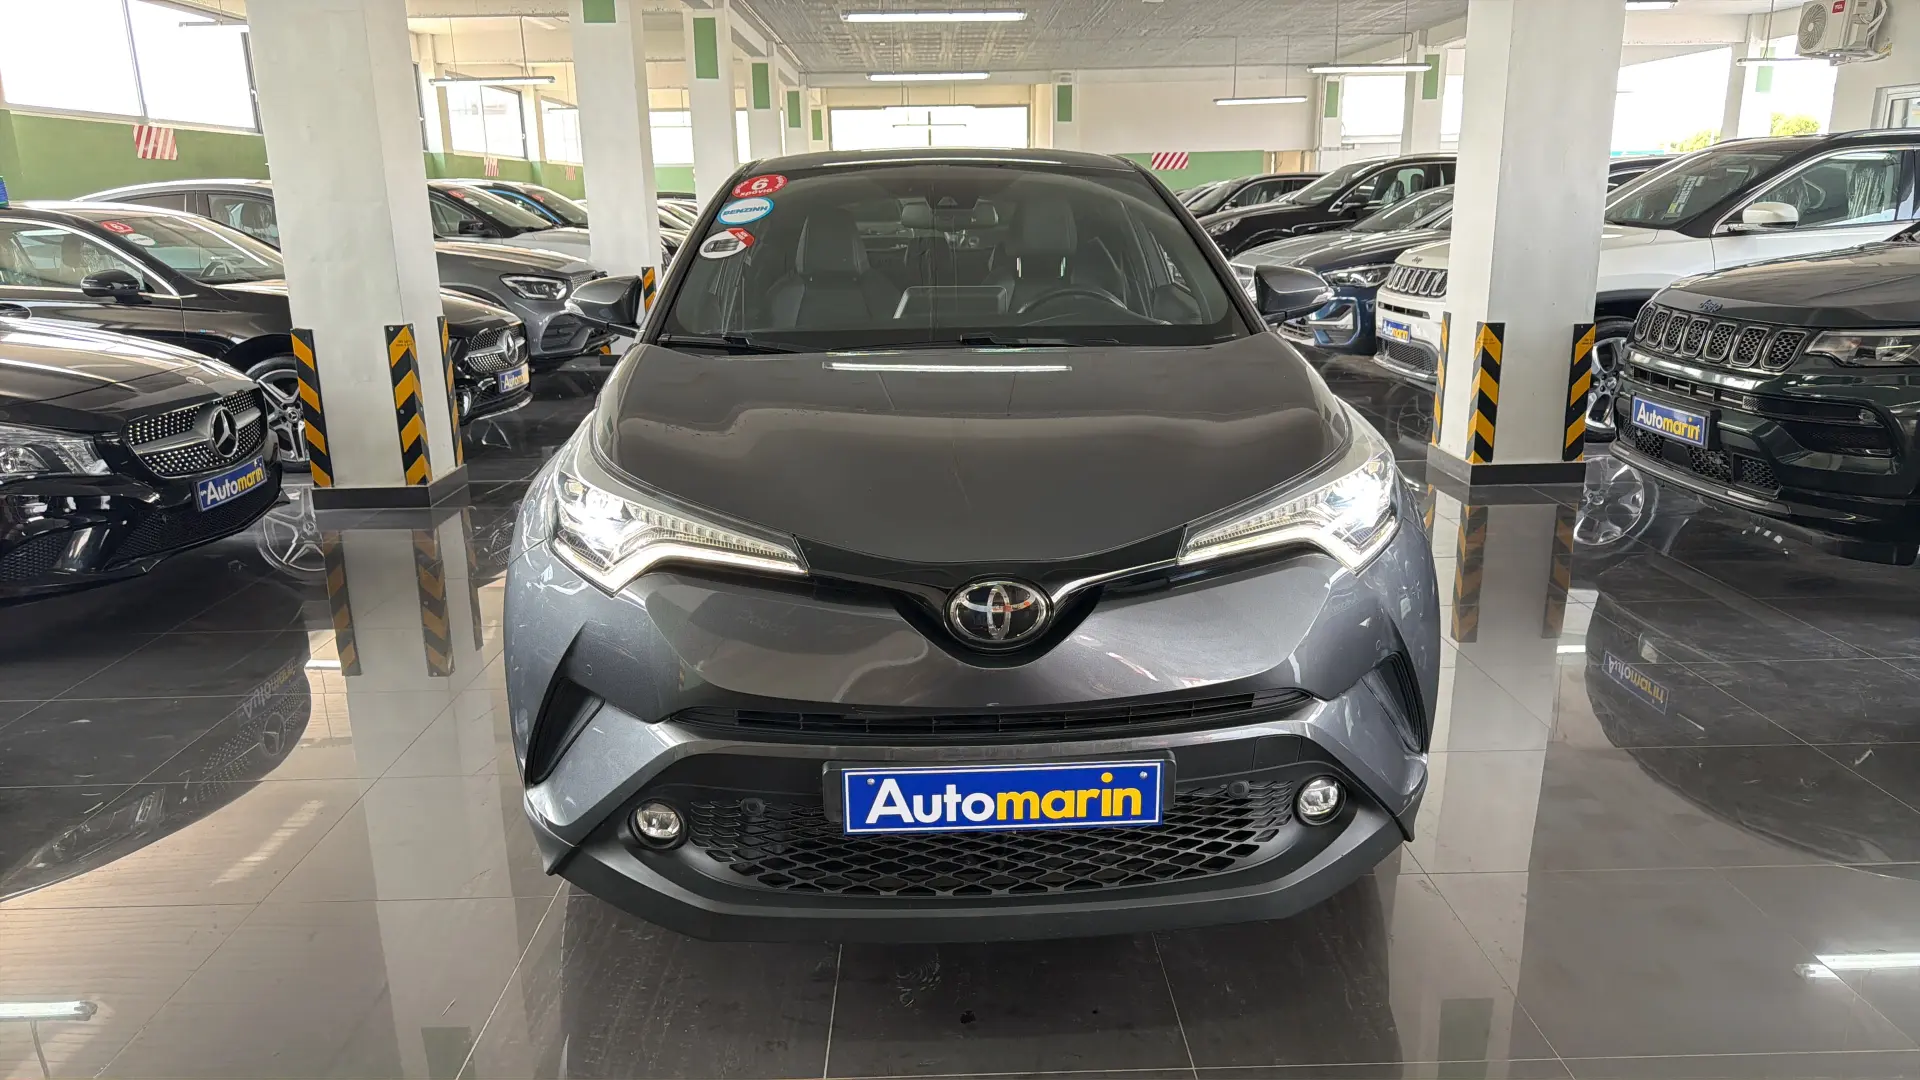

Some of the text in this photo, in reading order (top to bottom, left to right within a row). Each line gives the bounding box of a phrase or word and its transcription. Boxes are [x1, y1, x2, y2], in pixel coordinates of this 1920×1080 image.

[751, 178, 770, 191] 6
[1636, 402, 1700, 440] Automarin
[207, 460, 264, 505] Automarin
[865, 772, 1142, 824] Automarin
